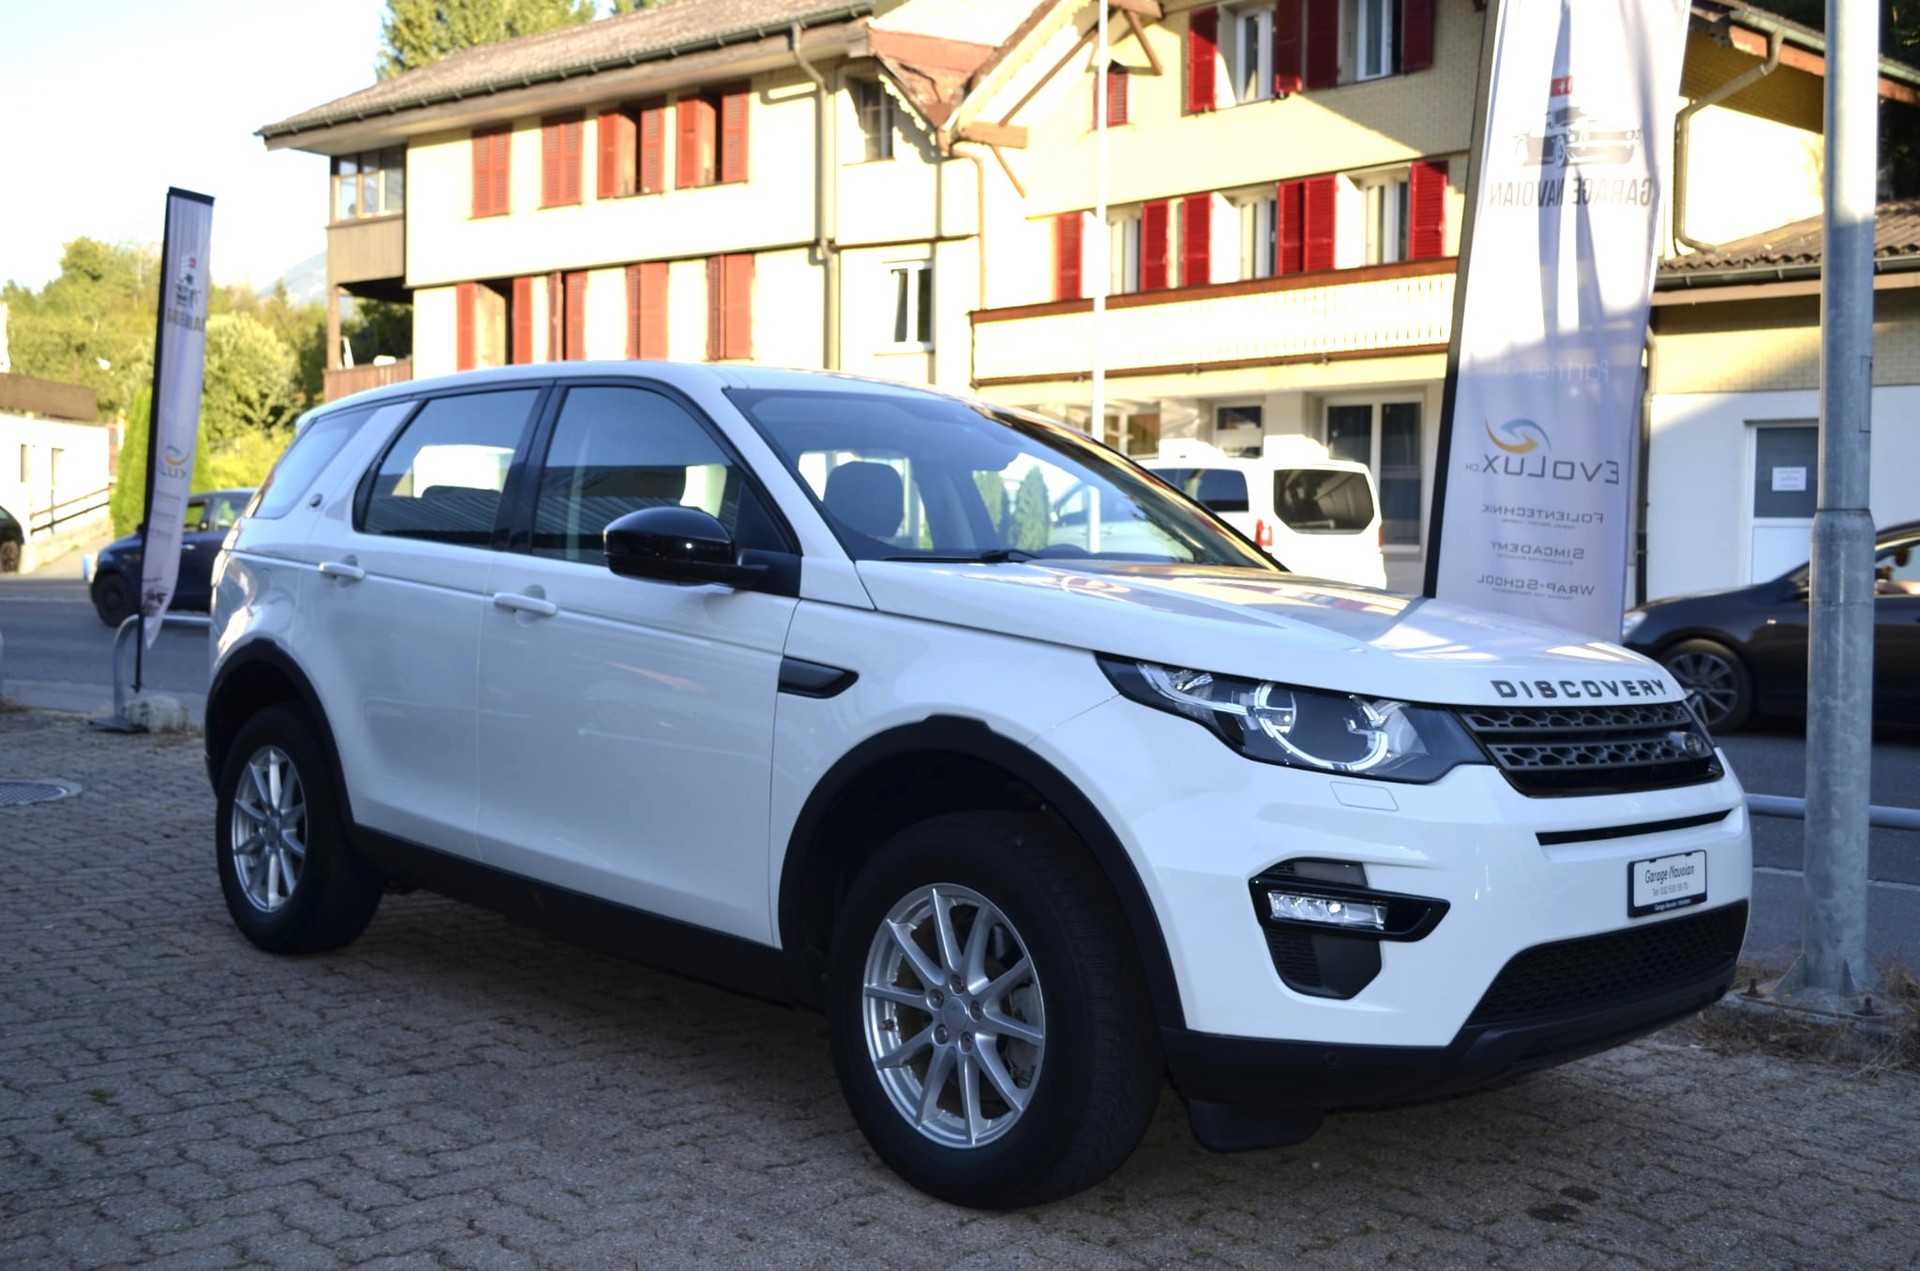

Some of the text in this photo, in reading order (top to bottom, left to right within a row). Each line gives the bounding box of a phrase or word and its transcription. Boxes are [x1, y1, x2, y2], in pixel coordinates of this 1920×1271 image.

[1490, 679, 1667, 699] DISCOVERY
[1645, 863, 1694, 885] Garage Navoian
